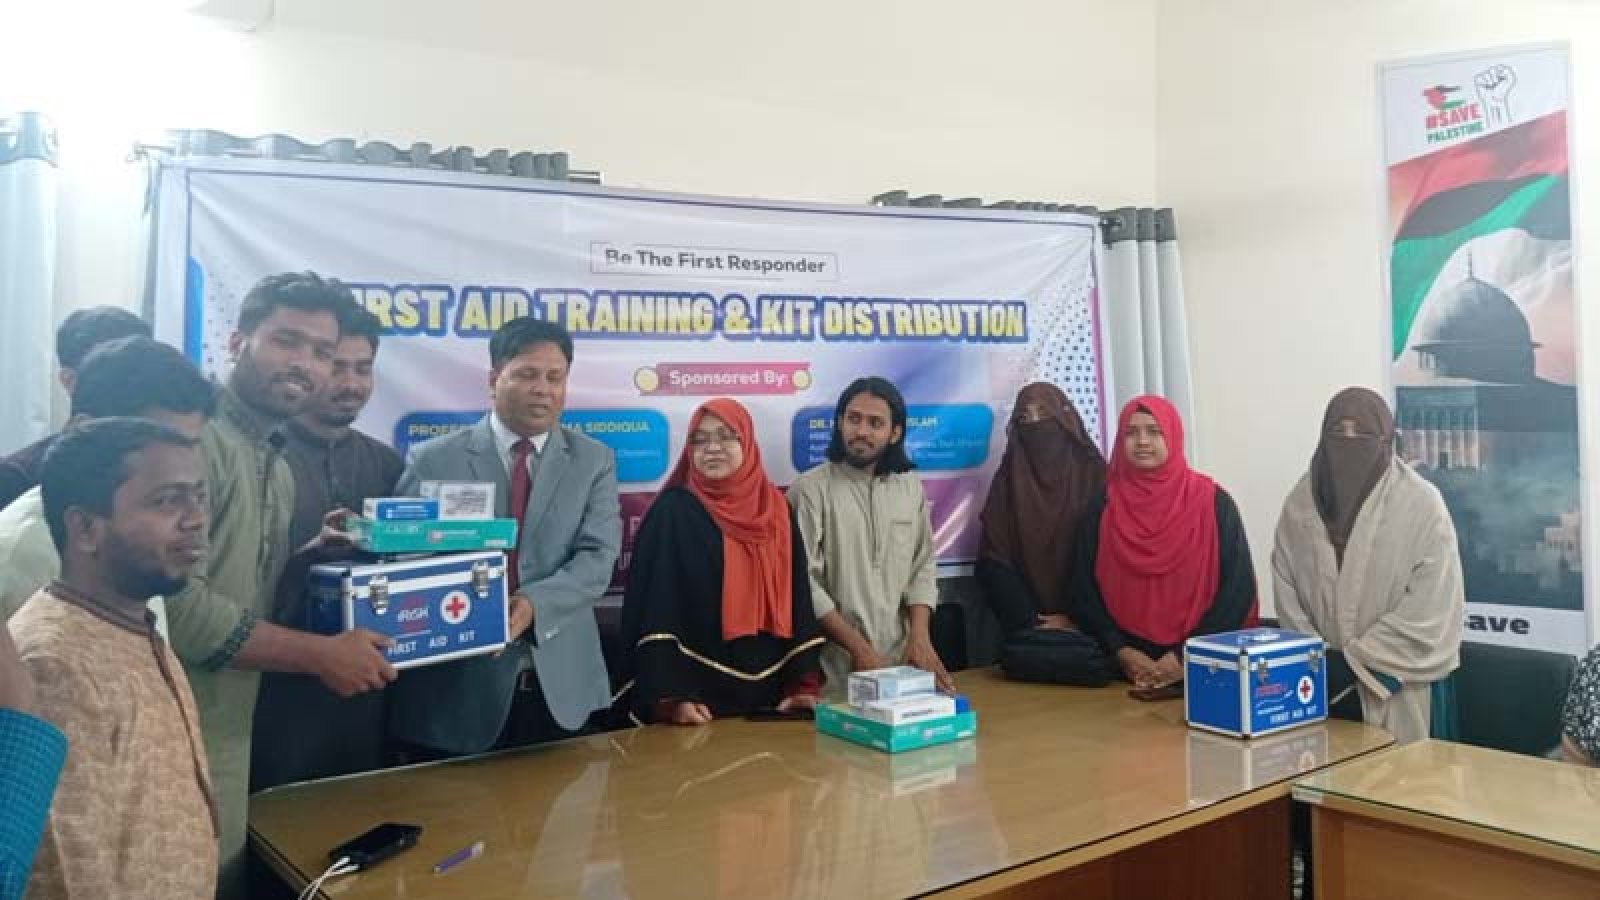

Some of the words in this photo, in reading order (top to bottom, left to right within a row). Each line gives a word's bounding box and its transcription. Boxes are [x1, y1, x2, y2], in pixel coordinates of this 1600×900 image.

[1427, 121, 1485, 144] PALESTINE
[636, 250, 673, 267] The
[678, 252, 723, 269] First
[728, 255, 826, 275] Responder
[540, 290, 714, 334] TRAINING
[723, 296, 750, 334] &
[760, 297, 815, 335] KIT
[824, 301, 1025, 338] DISTRIBUTION
[669, 369, 759, 388] Sponsored
[1464, 614, 1531, 635] ave
